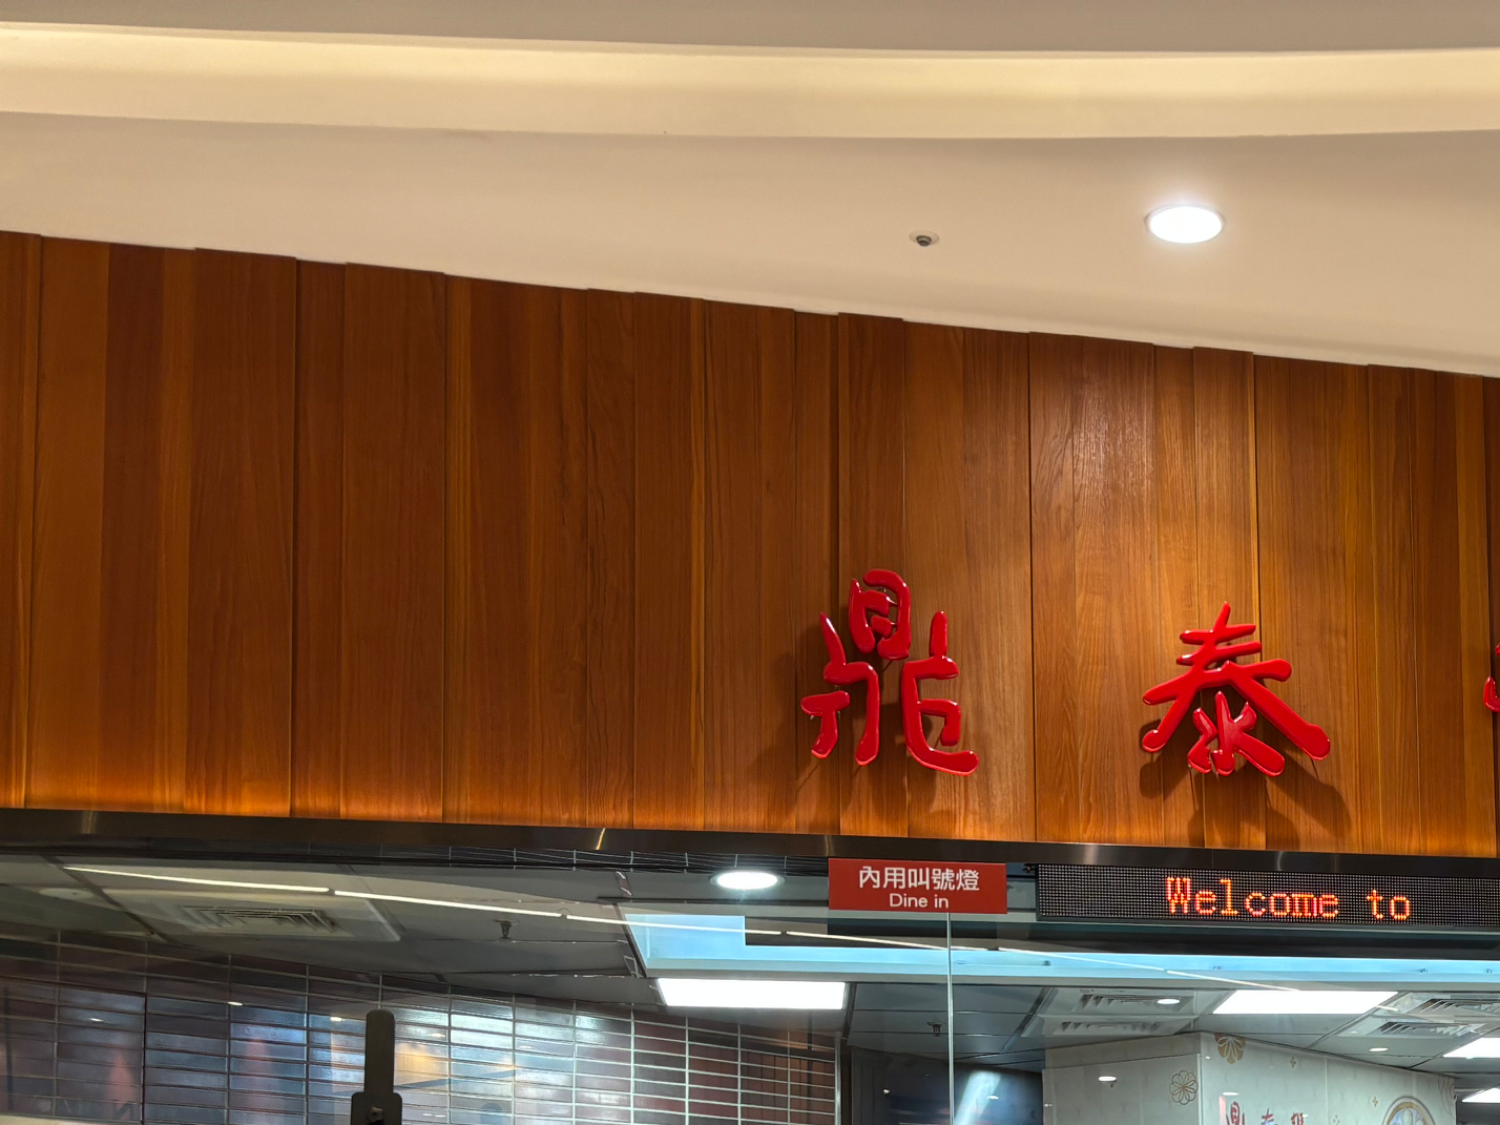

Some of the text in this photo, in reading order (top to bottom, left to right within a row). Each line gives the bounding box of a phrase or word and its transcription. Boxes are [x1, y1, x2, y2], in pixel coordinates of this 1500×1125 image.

[889, 893, 949, 909] Dine in
[1165, 876, 1411, 920] Welcome to
